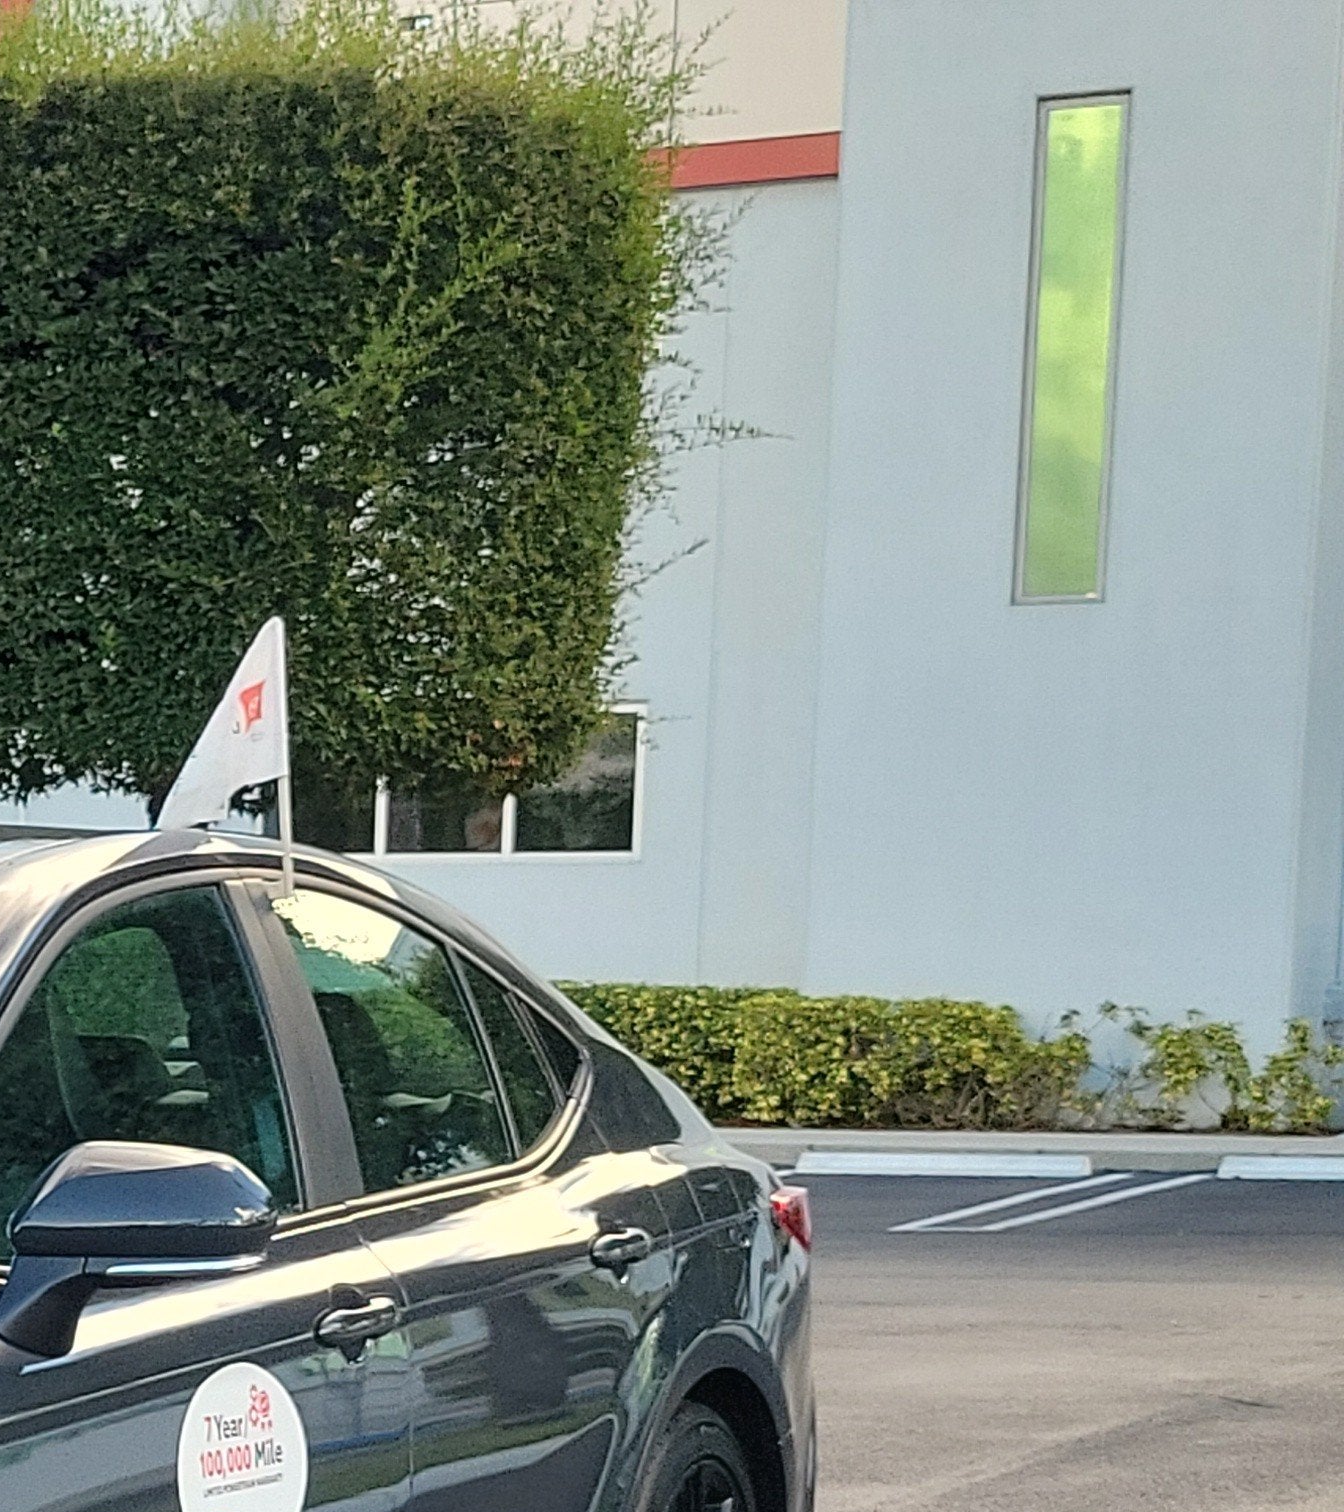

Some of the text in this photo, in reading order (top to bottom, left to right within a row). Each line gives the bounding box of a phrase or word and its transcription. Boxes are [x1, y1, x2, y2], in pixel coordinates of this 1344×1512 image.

[204, 1416, 213, 1442] 7
[200, 1439, 284, 1479] 100,000 Mile
